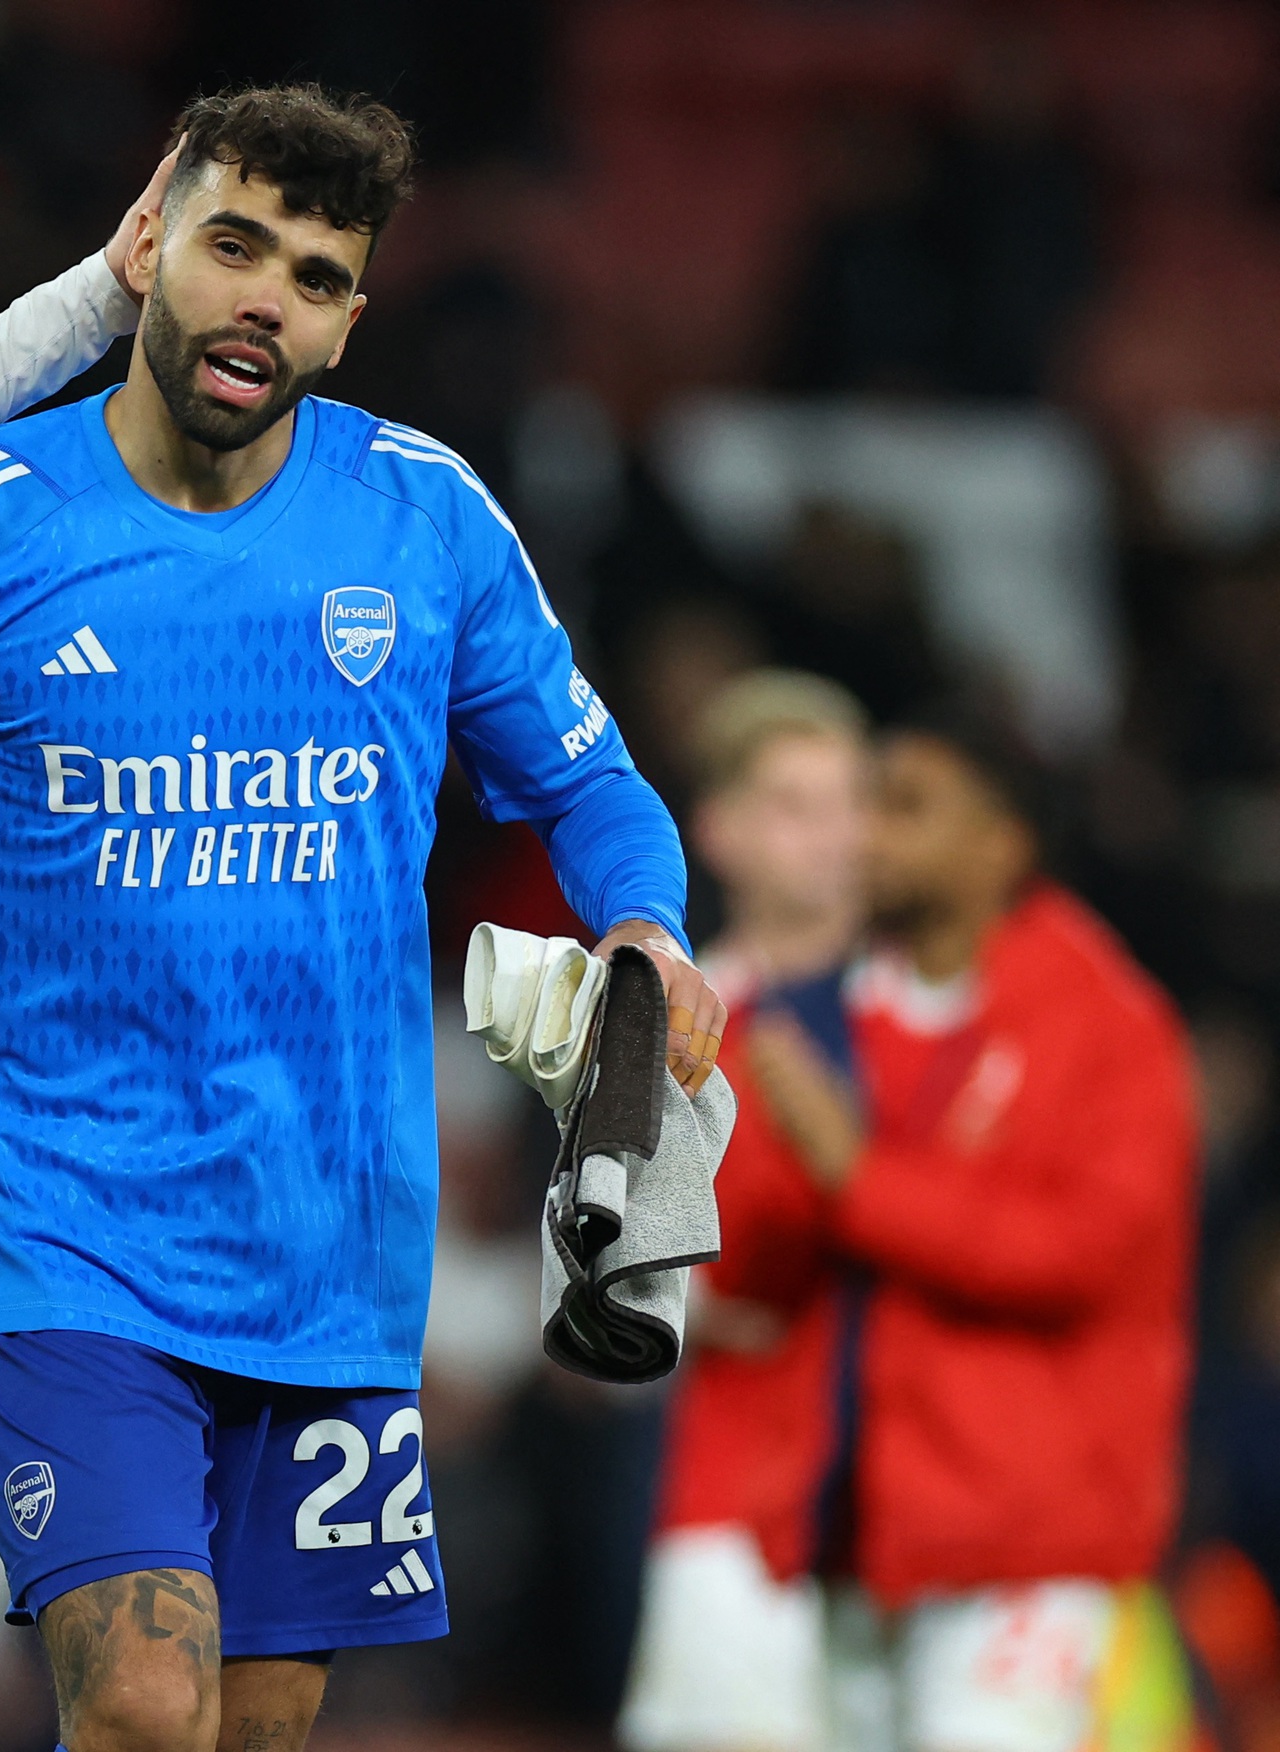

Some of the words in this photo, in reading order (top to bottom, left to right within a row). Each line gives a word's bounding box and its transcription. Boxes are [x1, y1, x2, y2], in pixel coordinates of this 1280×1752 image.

[333, 603, 386, 620] Arsenal
[38, 733, 386, 815] Emirates
[95, 828, 176, 888] FLY
[187, 820, 339, 887] BETTER
[10, 1471, 44, 1497] Arsenal
[293, 1407, 434, 1550] 22
